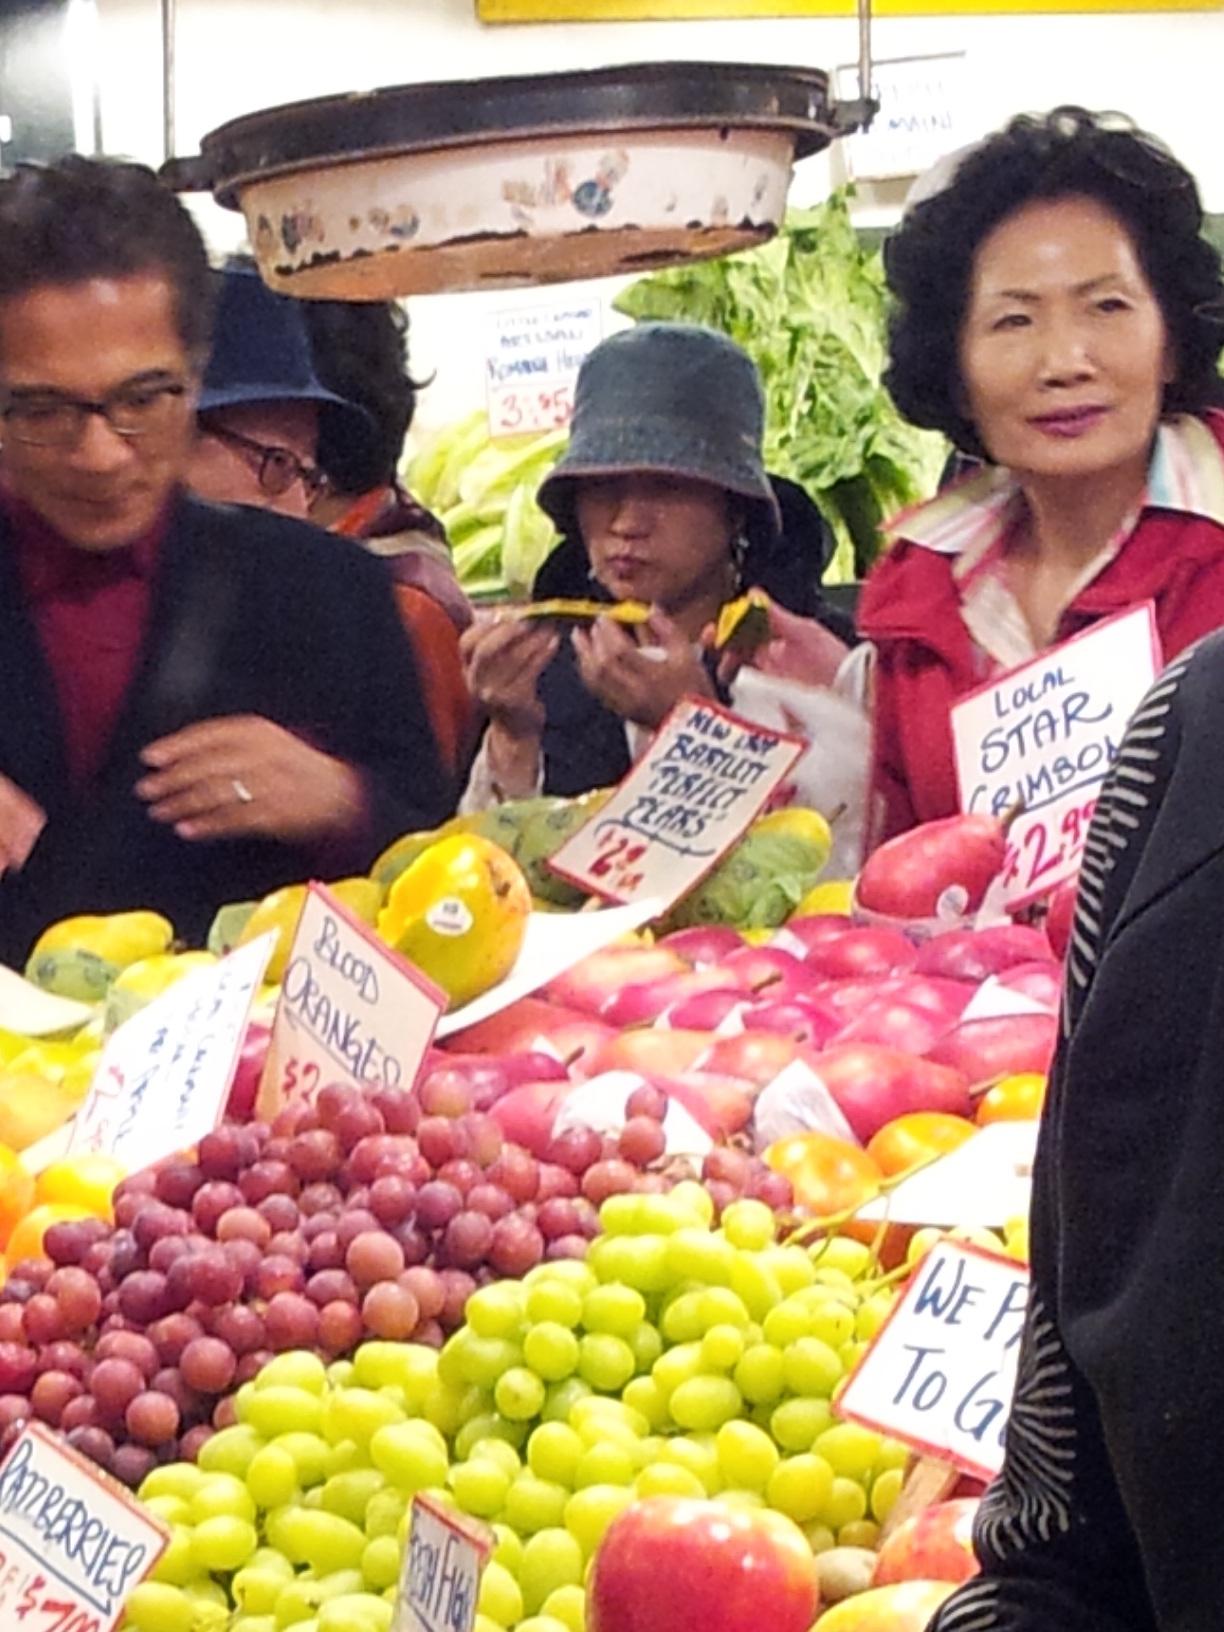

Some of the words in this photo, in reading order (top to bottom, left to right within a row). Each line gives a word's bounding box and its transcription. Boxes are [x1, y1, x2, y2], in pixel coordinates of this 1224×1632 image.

[994, 666, 1075, 719] LOCAL
[980, 692, 1113, 773] STAR
[314, 916, 380, 1004] BLOOD
[283, 957, 402, 1086] ORANGES
[913, 1256, 986, 1325] WE
[892, 1343, 948, 1412] TO
